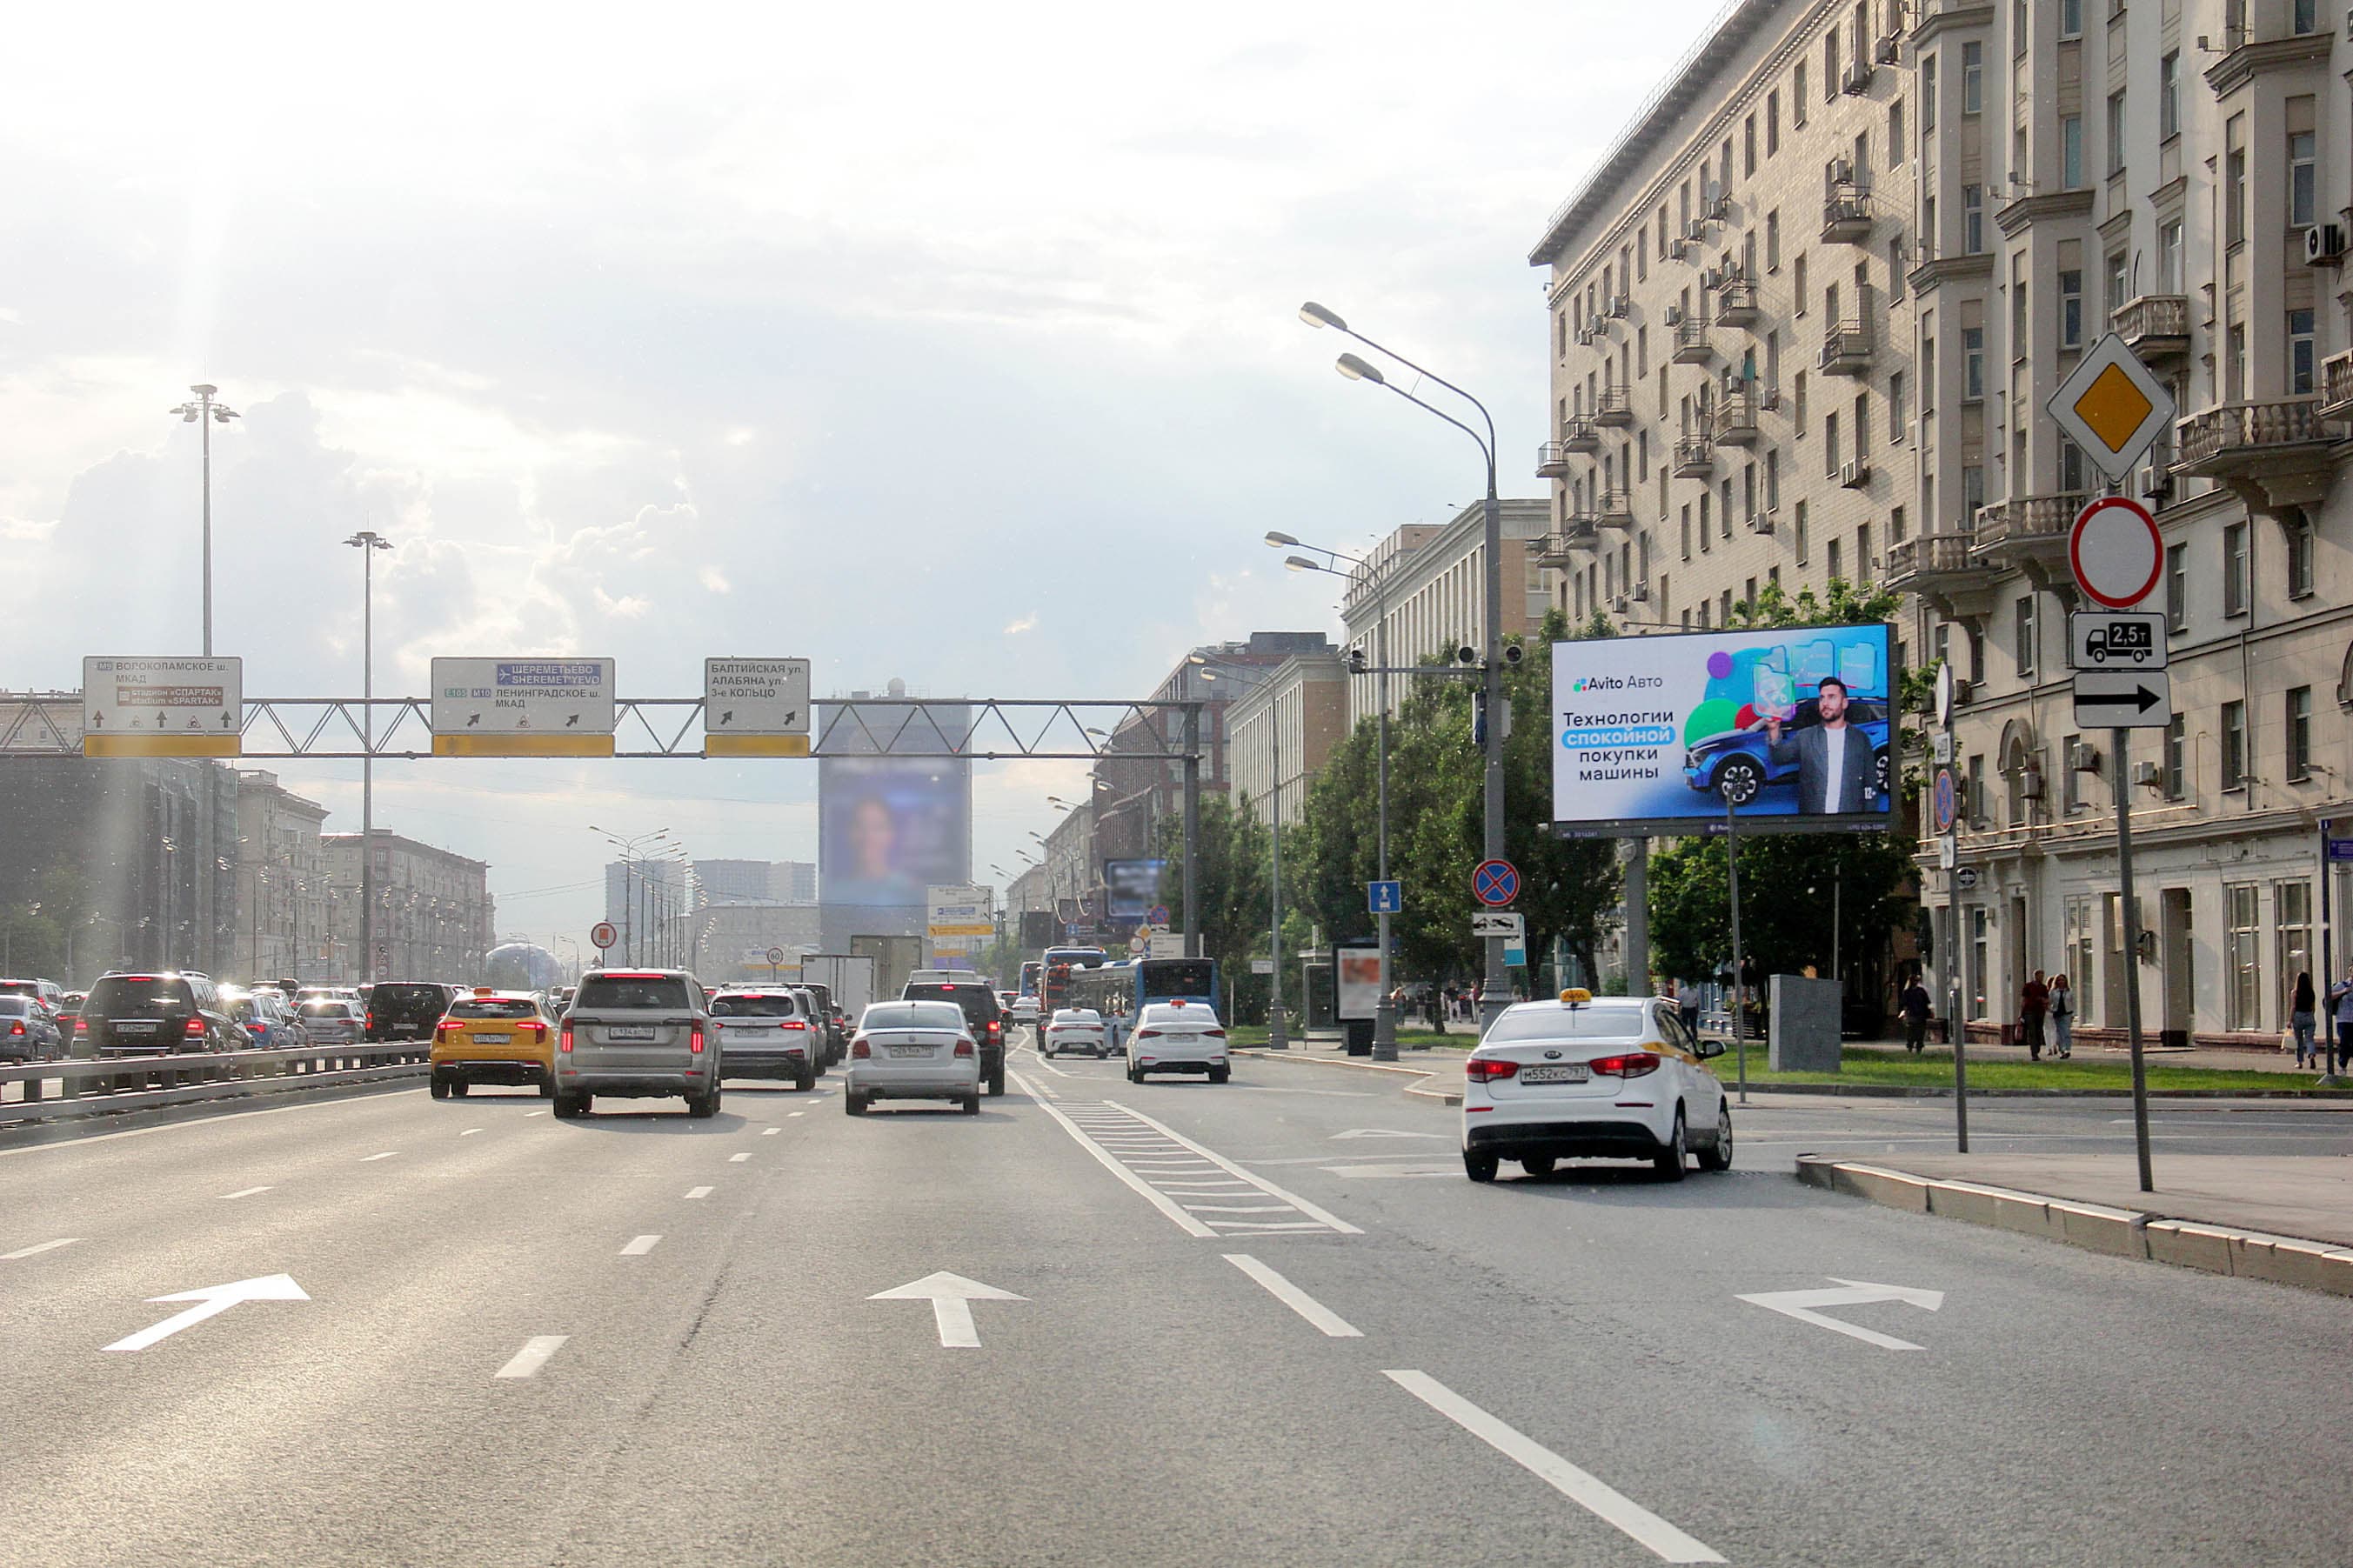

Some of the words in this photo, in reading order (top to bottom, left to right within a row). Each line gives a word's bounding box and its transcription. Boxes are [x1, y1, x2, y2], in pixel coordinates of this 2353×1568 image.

[116, 662, 214, 671] ВОЛОКОЛАМСКОЕ
[511, 665, 593, 674] ШЕРЕМЕТЬЕВО
[712, 663, 785, 673] БАЛТИЙСКАЯ
[788, 666, 804, 675] ул.
[116, 674, 147, 684] МКАД
[712, 677, 765, 685] АЛАБЯНА
[1588, 676, 1624, 691] Avito
[1627, 675, 1663, 689] Авто
[170, 688, 222, 697] «СПАРТАК»
[495, 689, 586, 698] ЛЕНИНГРАДСКОЕ
[711, 689, 727, 697] 3-е
[730, 689, 776, 698] КОЛЬЦО
[495, 700, 525, 709] МКАД
[1562, 711, 1674, 727] Технологии
[1567, 725, 1670, 746] спокойной
[1580, 749, 1658, 765] покупки
[1580, 767, 1658, 781] машины
